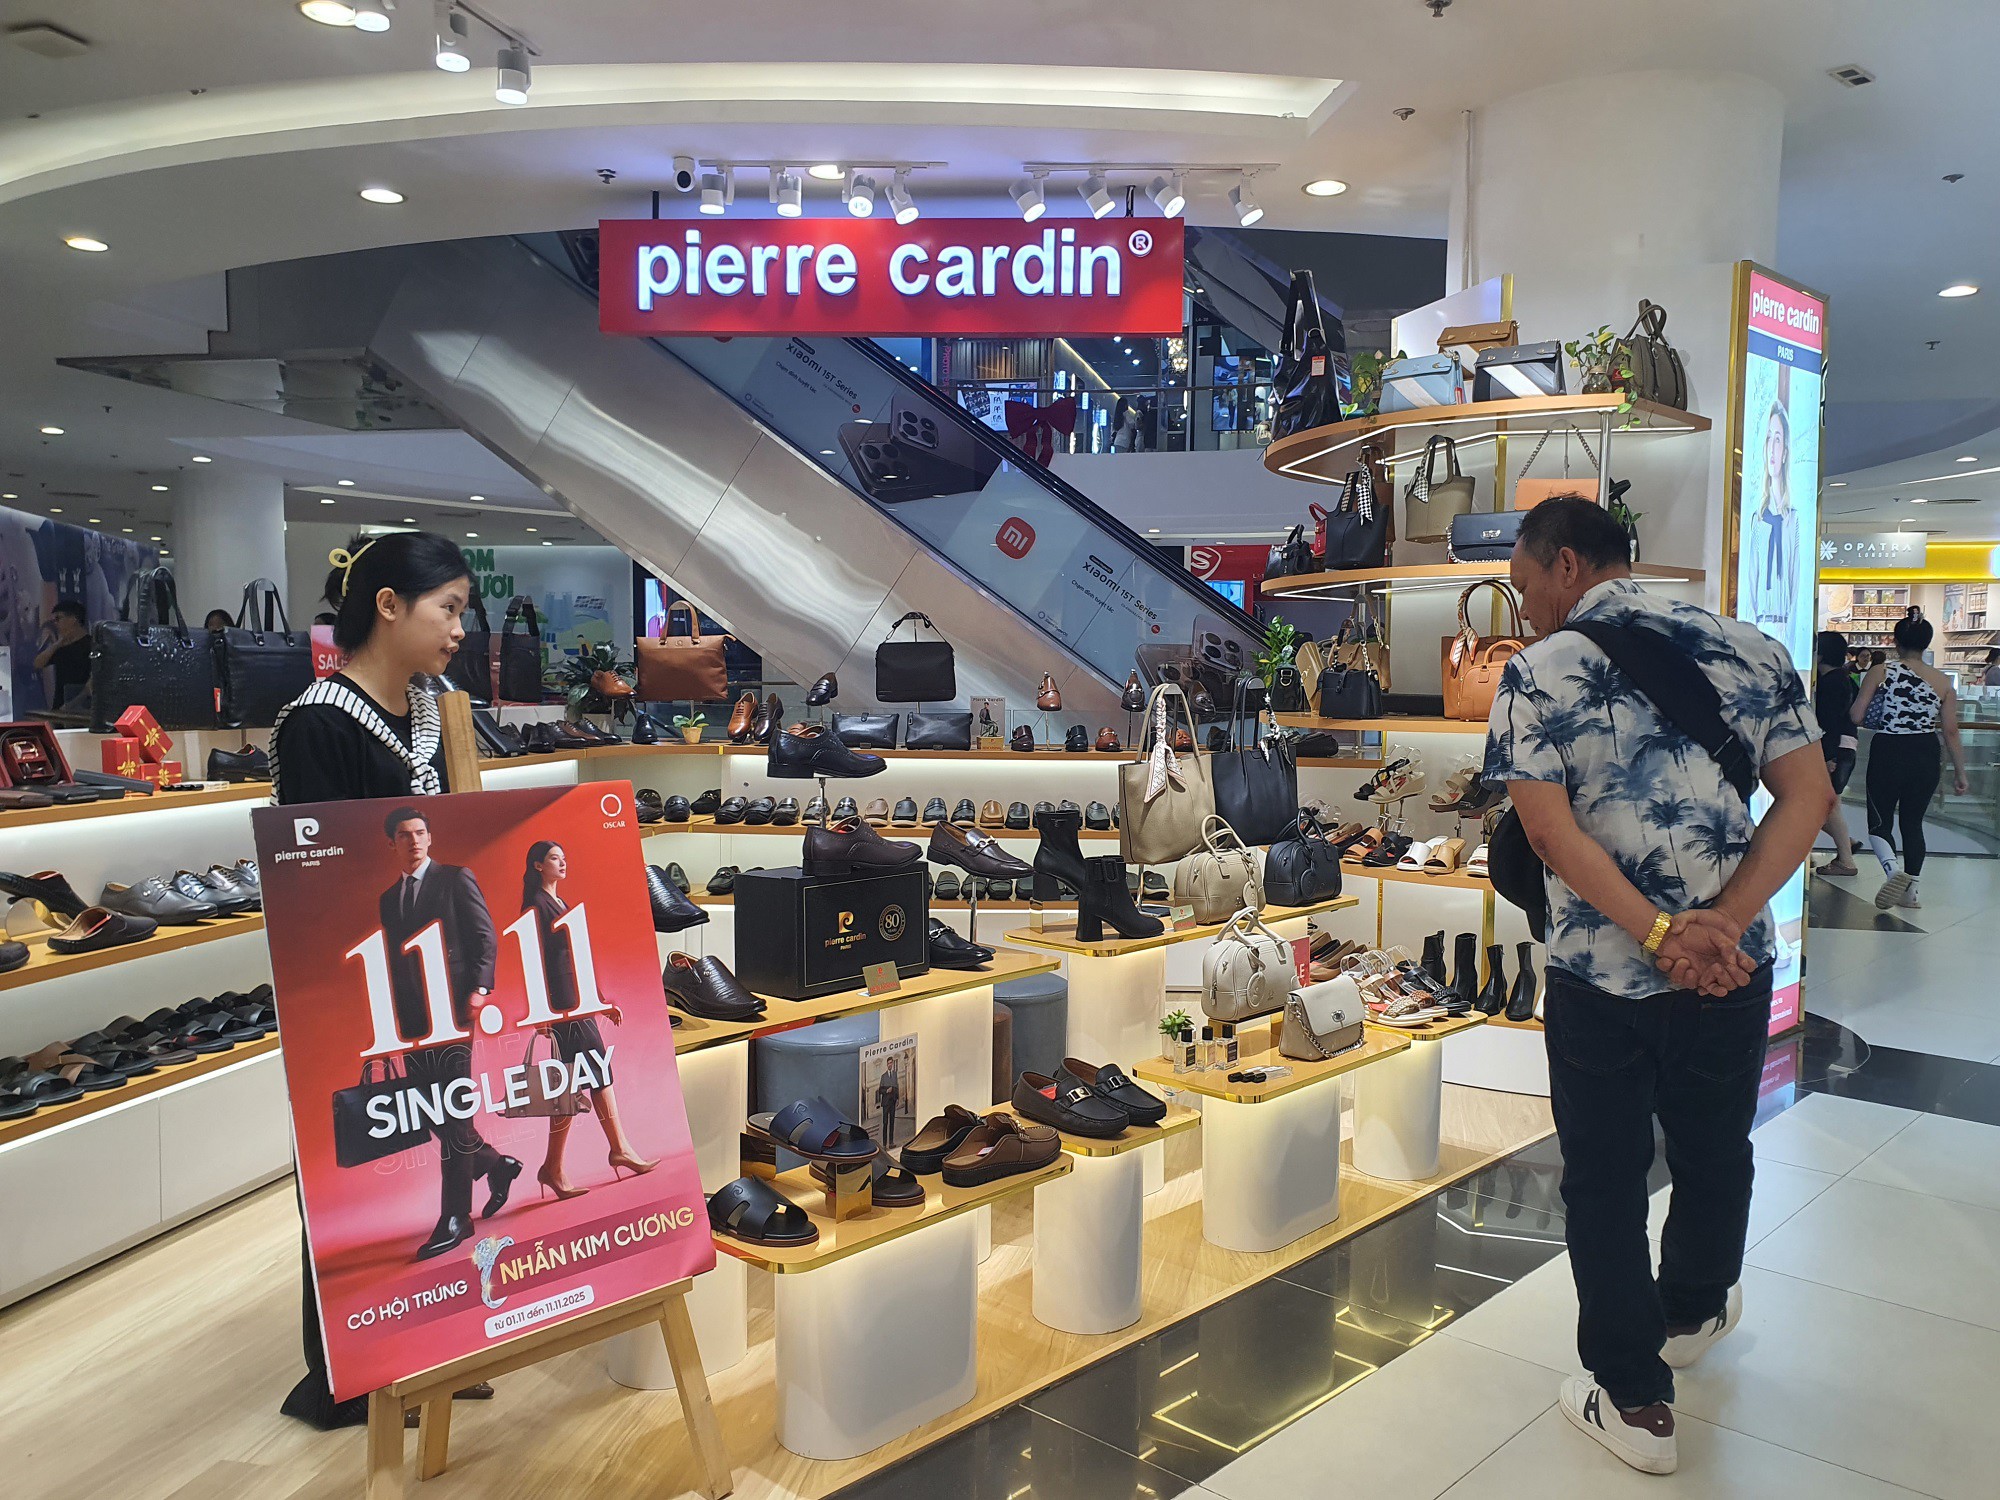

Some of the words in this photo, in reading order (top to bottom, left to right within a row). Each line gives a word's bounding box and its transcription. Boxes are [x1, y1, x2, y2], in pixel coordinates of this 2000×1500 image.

[638, 229, 857, 311] pierre
[889, 227, 1121, 297] cardin
[1752, 289, 1785, 323] pierre
[1787, 306, 1820, 335] cardin
[1777, 345, 1794, 361] PARIS
[822, 369, 836, 382] 15T
[835, 379, 858, 400] Series
[1844, 542, 1912, 551] OPATRA
[1120, 589, 1135, 603] 15T
[1134, 599, 1158, 620] Series
[603, 820, 626, 829] OSCAR
[275, 850, 307, 863] pierre
[309, 846, 344, 858] cardin
[301, 860, 321, 868] PARIS
[824, 937, 845, 948] pierre
[845, 932, 867, 942] cardin
[345, 901, 613, 1058] 11.11
[864, 1046, 887, 1058] Pierre
[889, 1038, 914, 1051] Cardin
[366, 1064, 531, 1139] SINGLE
[538, 1045, 615, 1100] DAY
[499, 1240, 567, 1285] NHẪN
[570, 1231, 610, 1262] KIM
[614, 1206, 694, 1247] CƯƠNG
[347, 1307, 376, 1330] CƠ
[379, 1297, 410, 1320] HỘI
[412, 1280, 468, 1309] TRÚNG
[494, 1320, 505, 1330] từ
[505, 1311, 526, 1327] 01.11
[526, 1305, 545, 1320] đến
[545, 1291, 586, 1313] 11.11.2025
